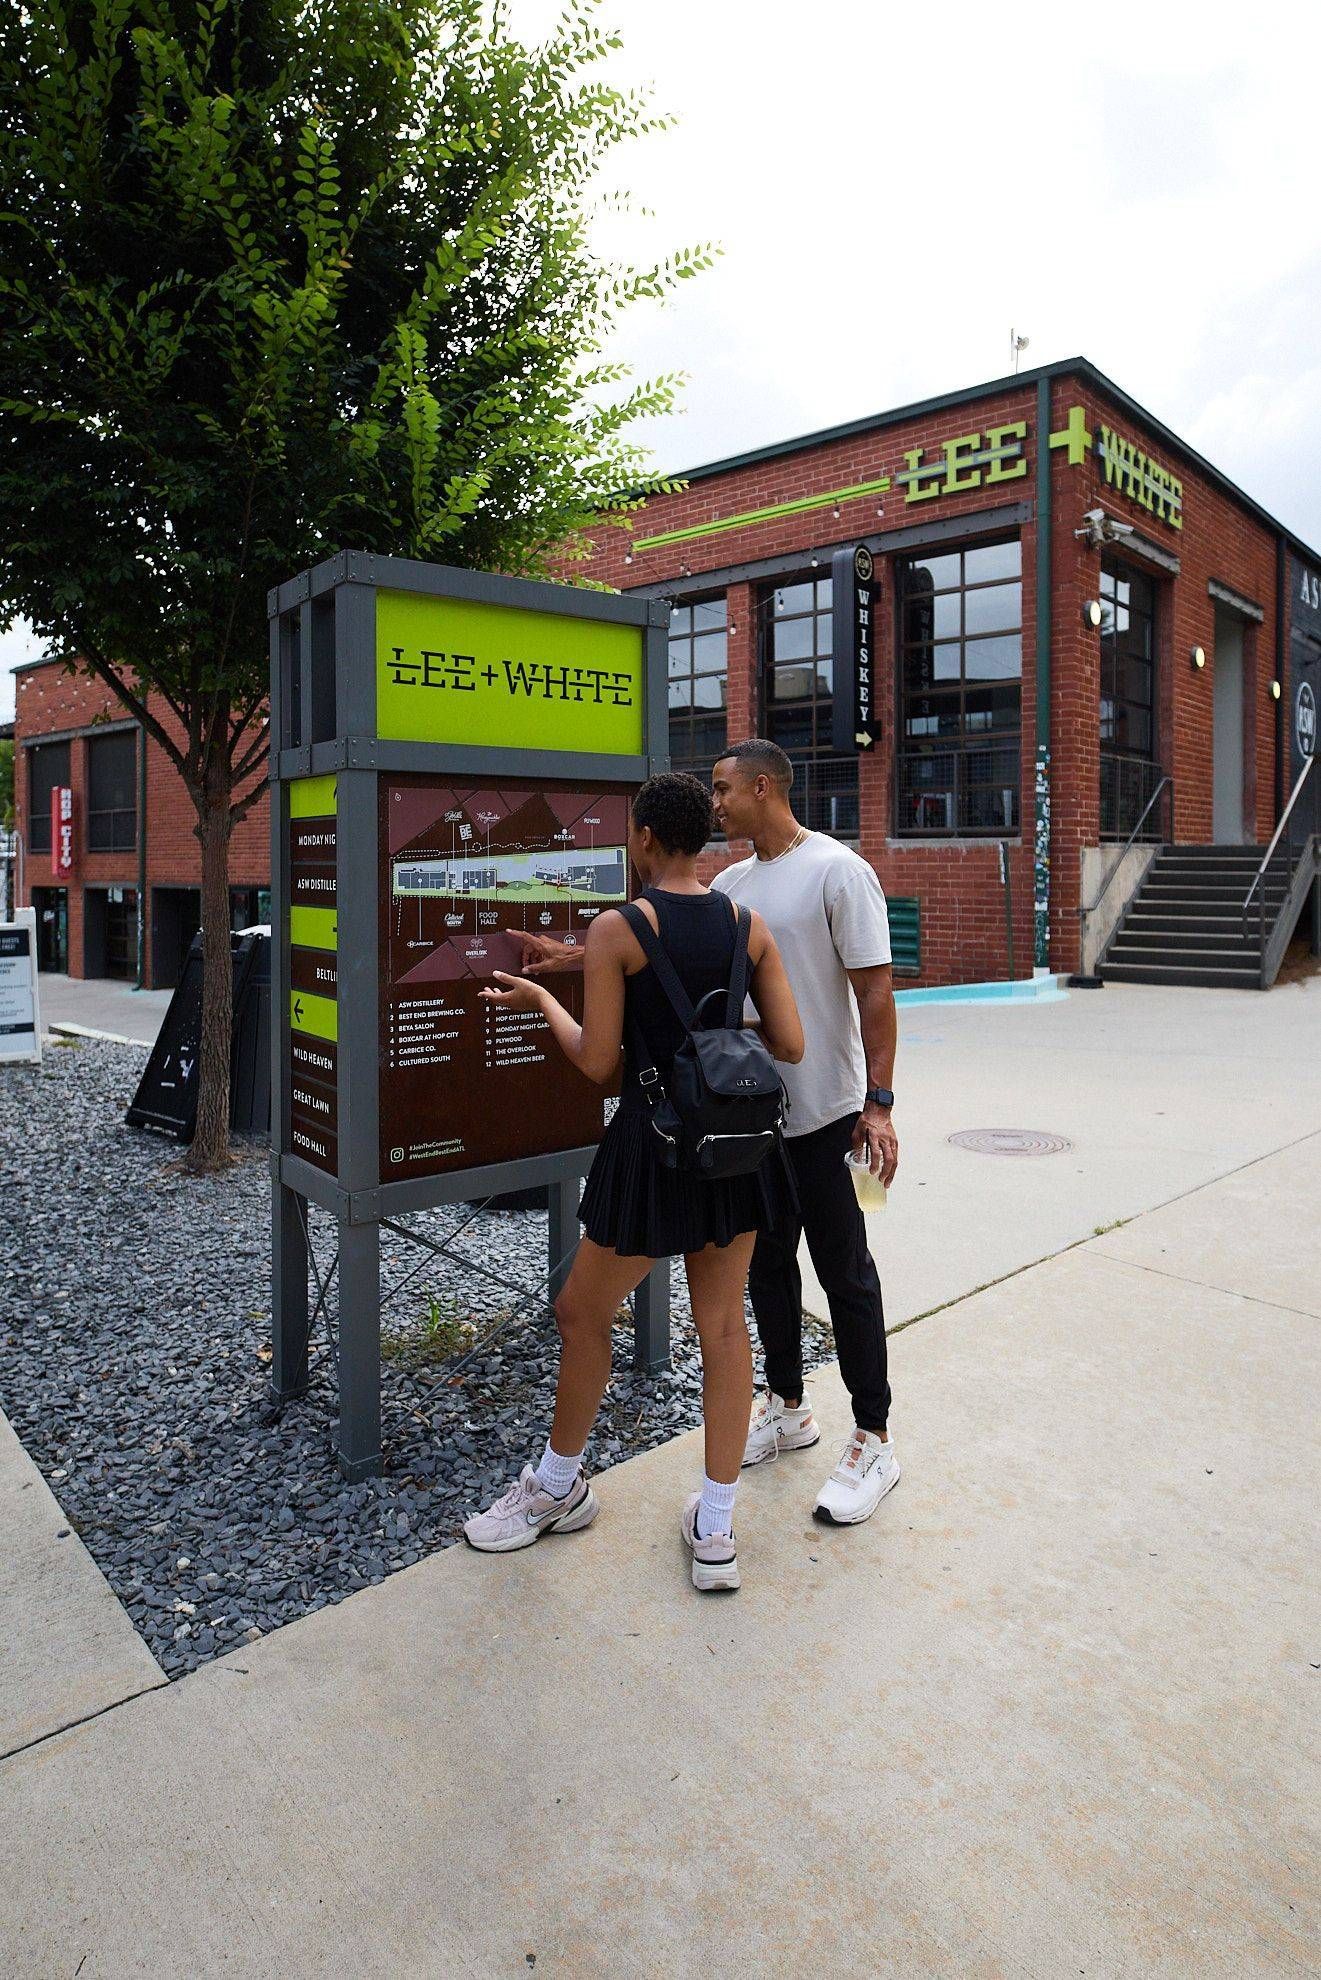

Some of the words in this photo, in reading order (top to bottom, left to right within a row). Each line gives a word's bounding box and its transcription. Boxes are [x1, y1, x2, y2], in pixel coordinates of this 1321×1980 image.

[897, 421, 1027, 503] LEE
[1097, 424, 1183, 530] WHITE
[1301, 569, 1321, 609] AS
[857, 588, 870, 722] WHISKEY
[298, 835, 324, 846] MONDAY
[324, 833, 336, 845] NIG
[298, 878, 309, 890] ASW
[310, 878, 337, 891] DISTILLE
[479, 911, 498, 919] FOOD
[316, 967, 338, 982] BELTLI
[398, 1001, 412, 1009] ASW
[412, 999, 445, 1008] DISTILLERY
[398, 1012, 412, 1020] BEST
[413, 1011, 426, 1019] END
[427, 1009, 454, 1018] BREWING
[520, 1012, 535, 1020] BEER
[398, 1024, 414, 1032] BEYA
[414, 1022, 435, 1030] SALON
[495, 1025, 520, 1033] MONDAY
[519, 1023, 537, 1031] NIGHT
[398, 1035, 424, 1043] BOXCAR
[432, 1032, 446, 1040] HOP
[446, 1031, 459, 1039] CITY
[495, 1036, 523, 1044] PLYWOOD
[398, 1046, 424, 1055] CARBICE
[506, 1045, 537, 1054] OVERLOOK
[293, 1047, 308, 1061] WILD
[308, 1051, 333, 1071] HEAVEN
[398, 1057, 430, 1067] CULTURED
[430, 1055, 451, 1063] SOUTH
[495, 1058, 510, 1066] WILD
[510, 1056, 532, 1065] HEAVEN
[531, 1054, 545, 1062] BEER
[293, 1089, 312, 1106] GREAT
[312, 1097, 330, 1114] LAWN
[293, 1131, 310, 1148] FOOD
[310, 1140, 327, 1157] HALL
[408, 1138, 462, 1151] #JoinTheCommunity
